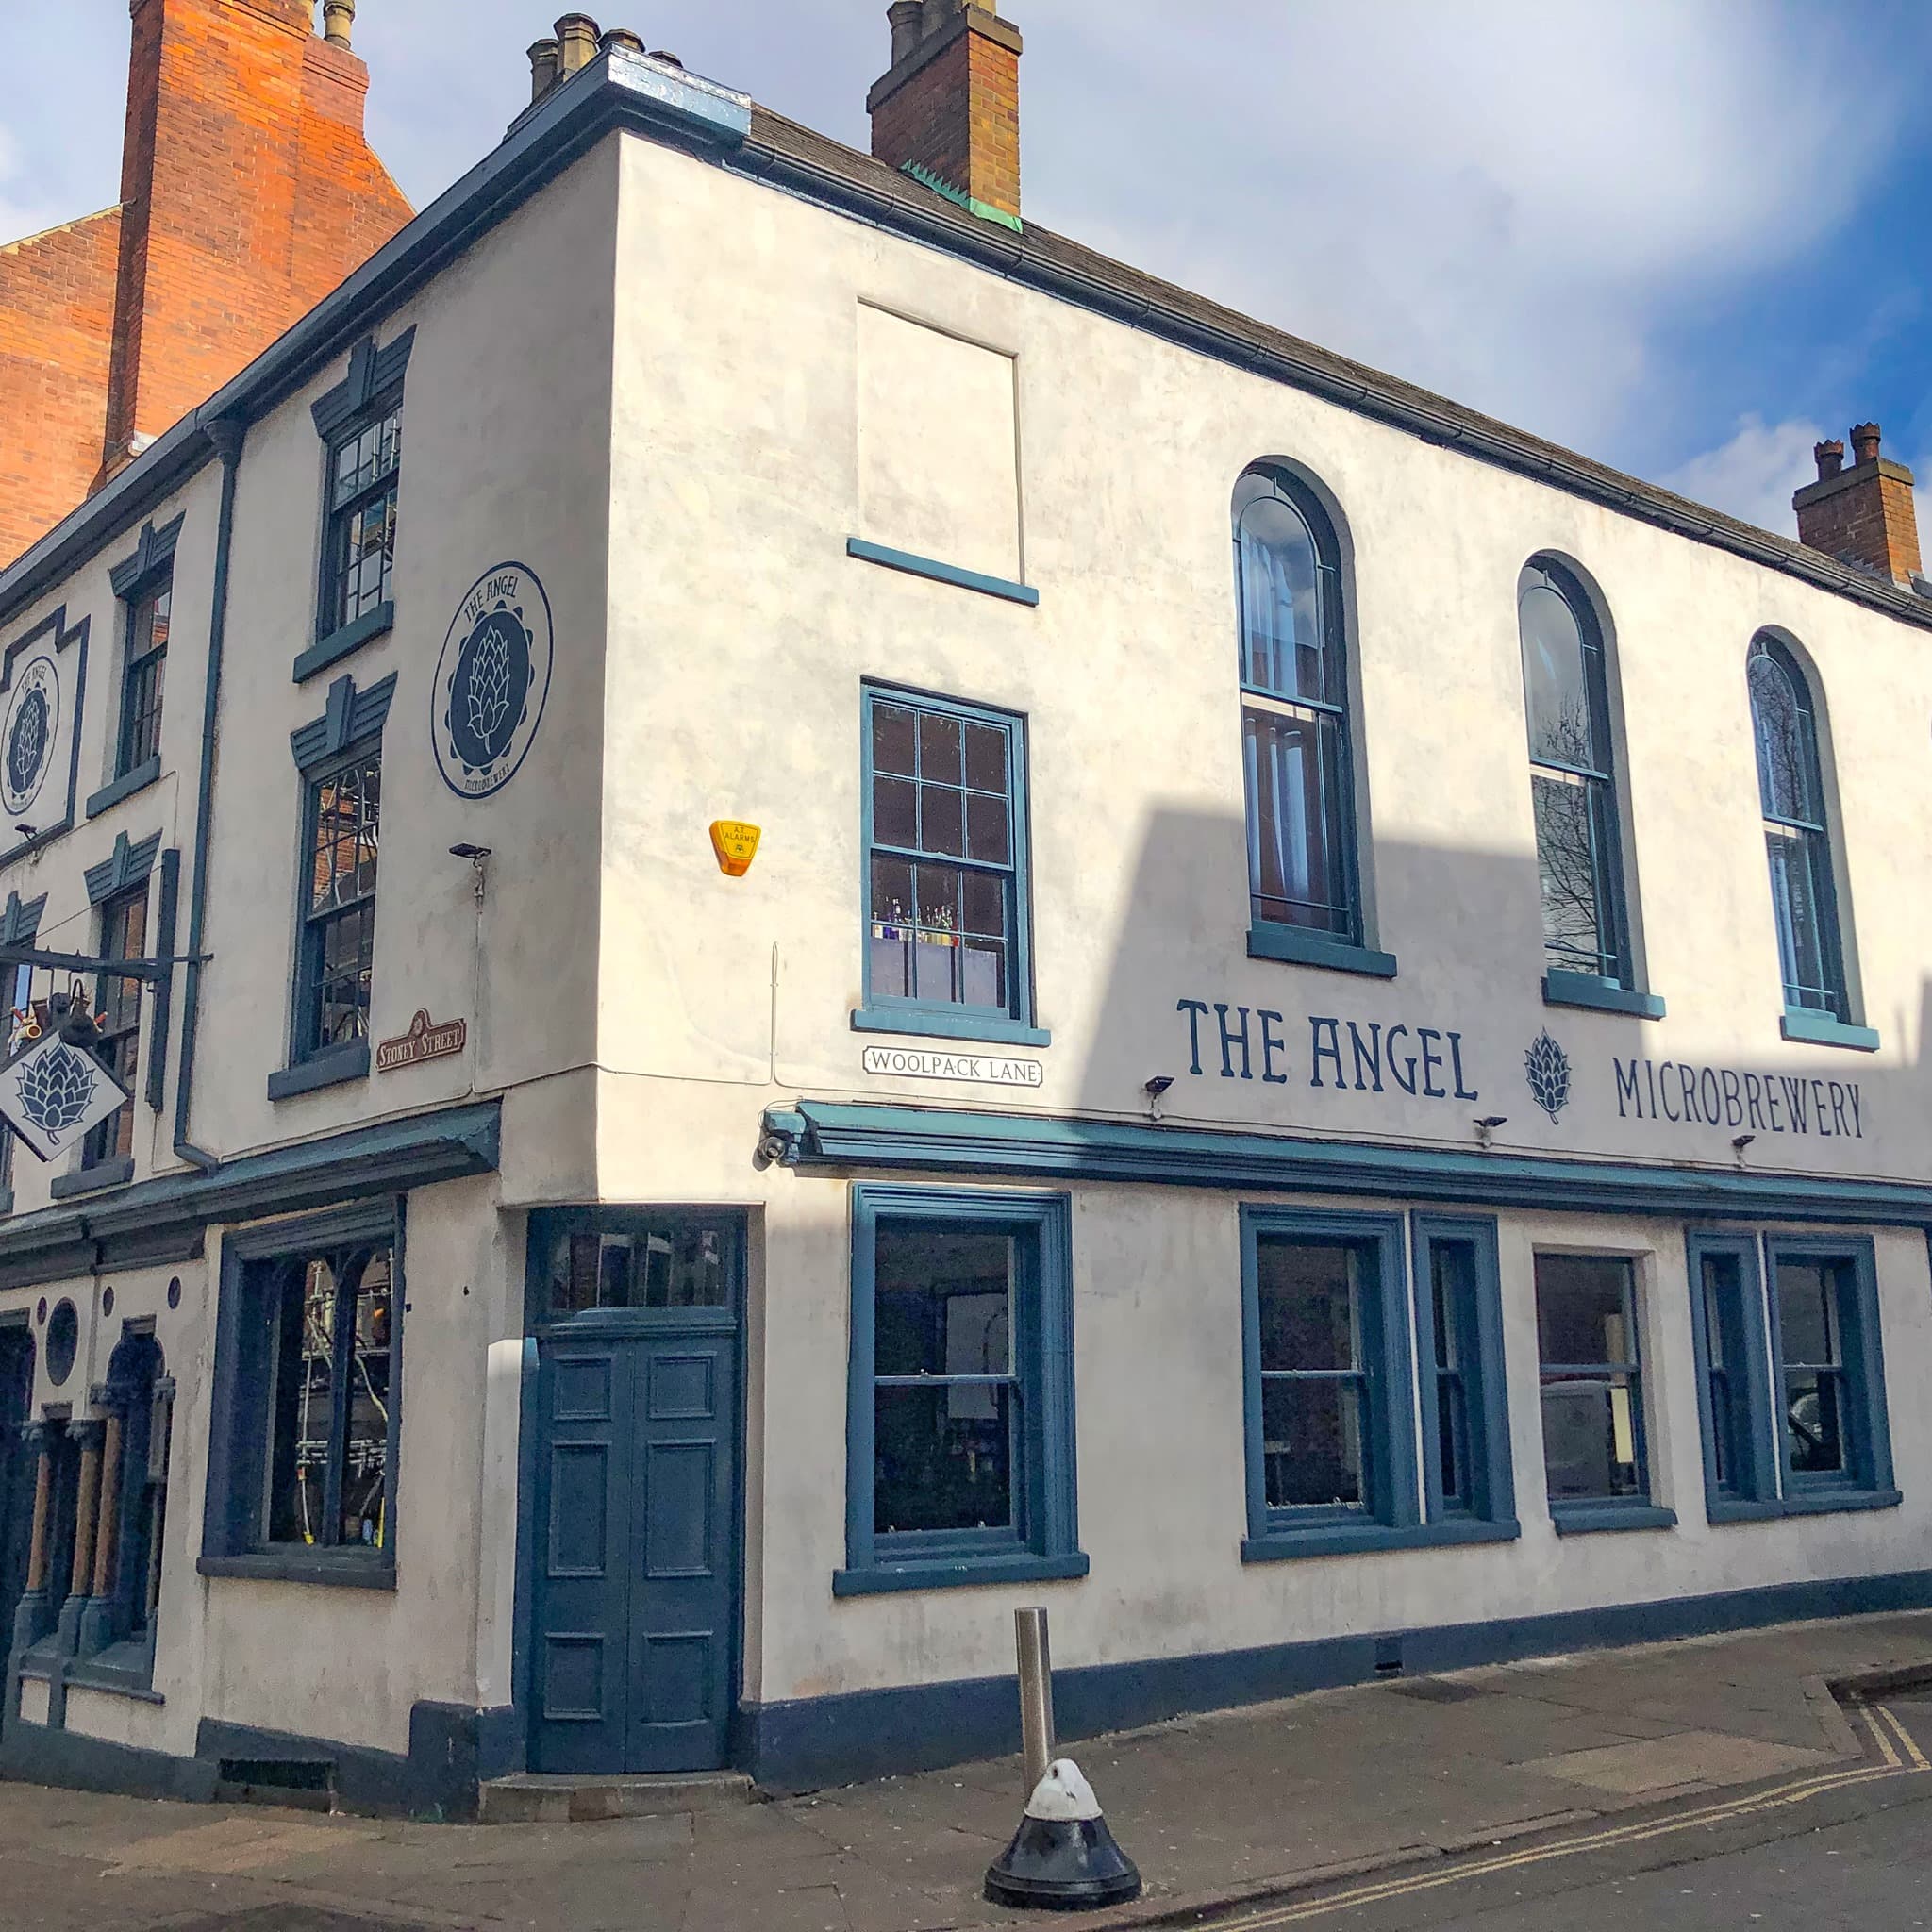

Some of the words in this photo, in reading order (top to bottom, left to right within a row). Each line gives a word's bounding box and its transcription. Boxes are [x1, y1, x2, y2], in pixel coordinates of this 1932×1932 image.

[463, 590, 484, 623] THE
[486, 575, 518, 602] ANGEL
[724, 833, 756, 842] ALARMS
[379, 1041, 416, 1066] STONEY
[421, 1028, 460, 1055] STREET
[871, 1051, 981, 1077] WOOLPACK
[989, 1061, 1038, 1082] LANE
[1176, 998, 1289, 1084] THE
[1308, 1016, 1479, 1101] ANGEL
[1612, 1057, 1863, 1139] MICROBREWERY
